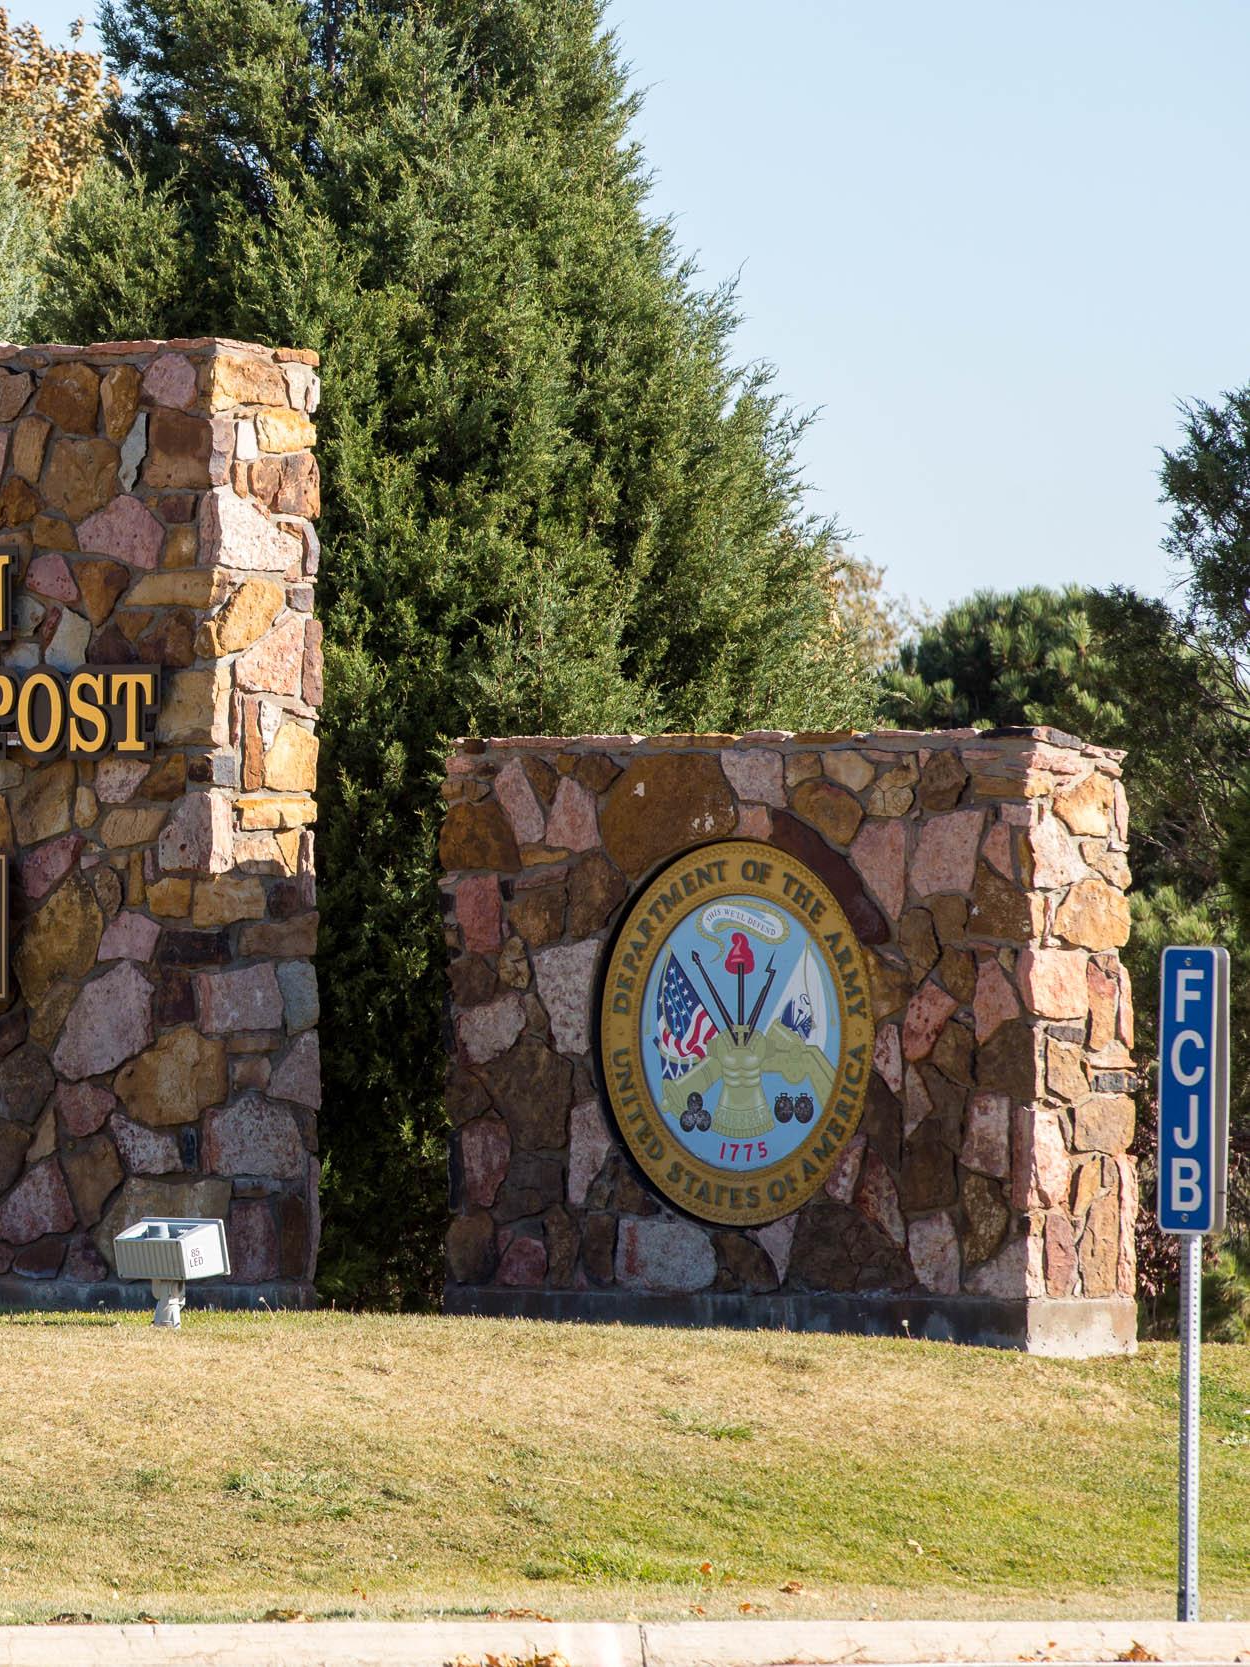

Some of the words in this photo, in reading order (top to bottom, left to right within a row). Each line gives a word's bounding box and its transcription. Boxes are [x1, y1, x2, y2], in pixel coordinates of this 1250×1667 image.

[706, 908, 721, 922] THIS
[747, 917, 776, 936] DEFEND
[612, 860, 729, 1015] DEPARTMENT
[741, 859, 773, 885] OF
[782, 872, 827, 924] THE
[823, 932, 867, 1019] ARMY
[612, 1047, 665, 1161] UNITED
[666, 1161, 760, 1209] STATES
[767, 1172, 798, 1202] OF
[802, 1043, 867, 1182] AMERICA
[719, 1141, 768, 1162] 1775
[189, 1256, 203, 1267] LED
[191, 1247, 200, 1257] 85
